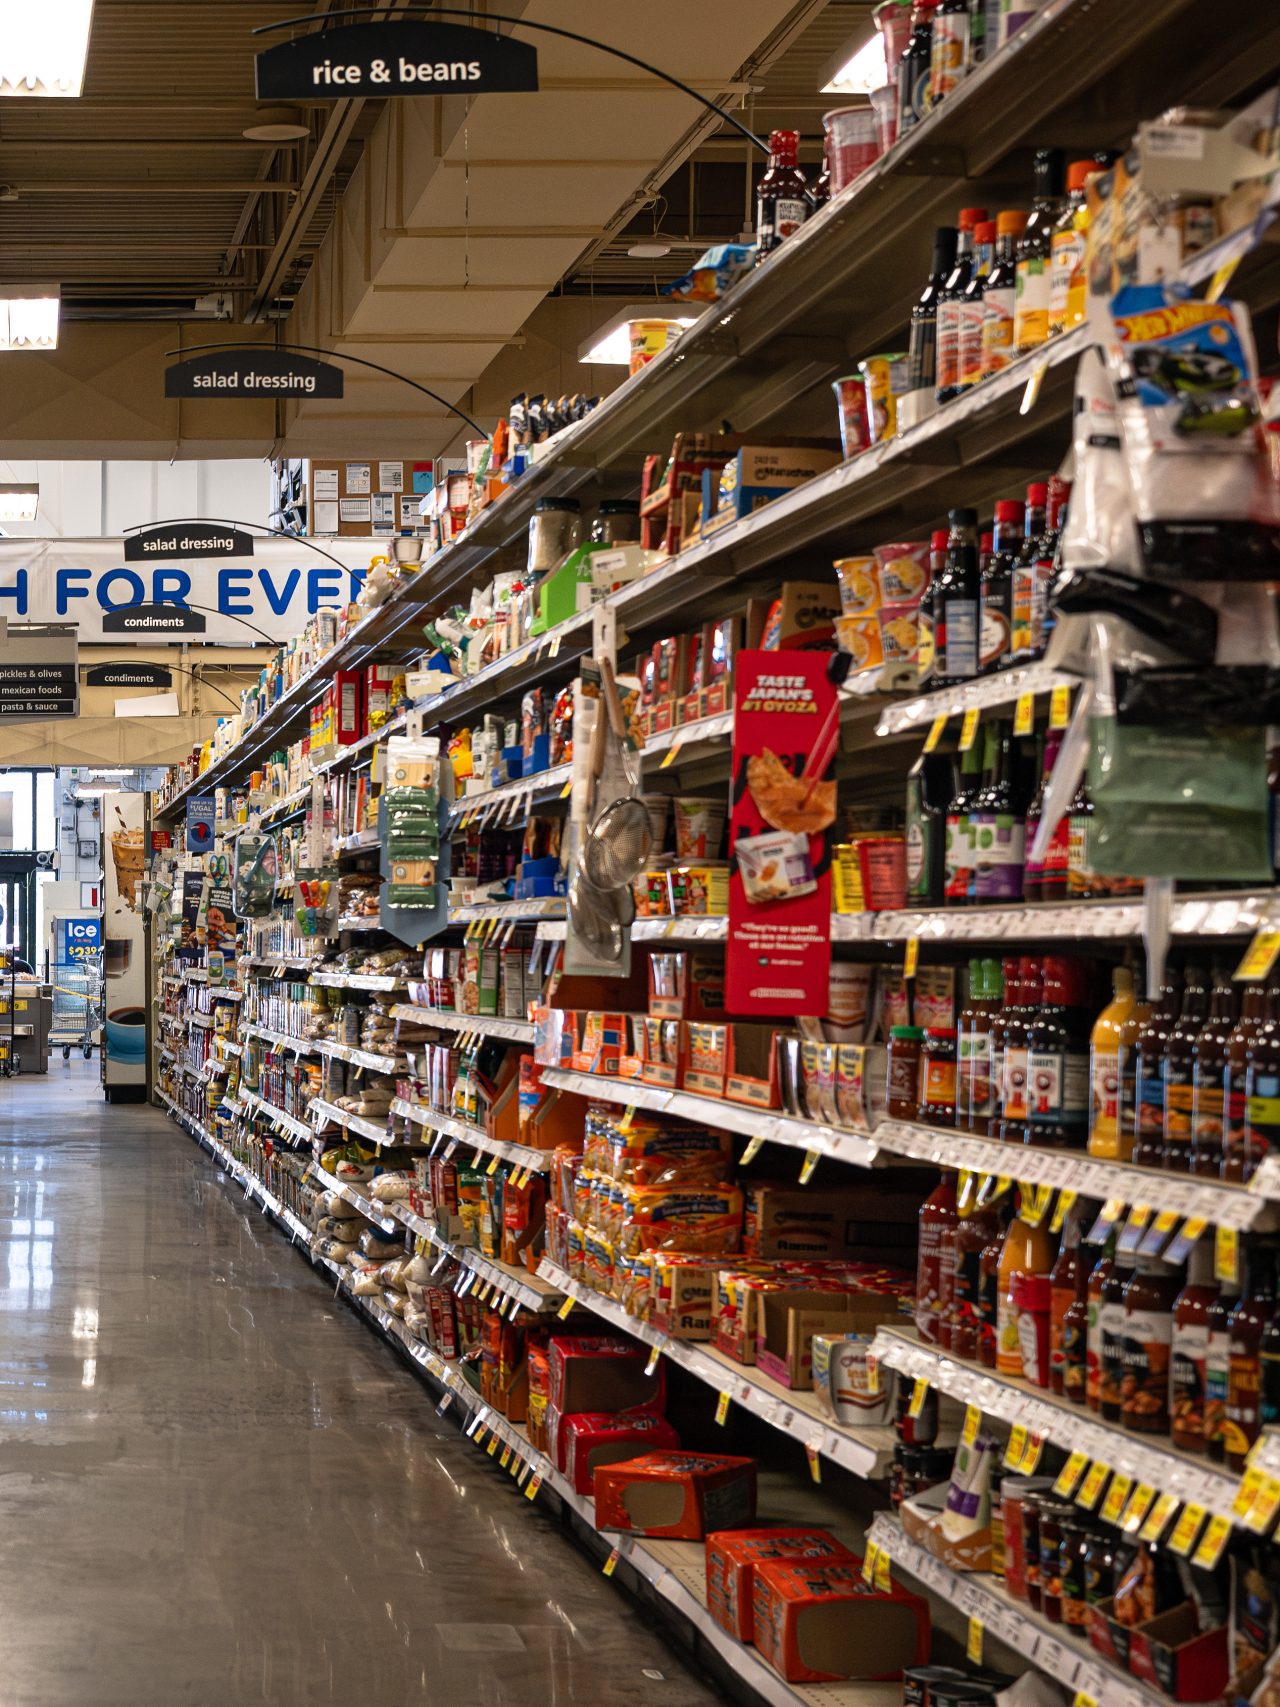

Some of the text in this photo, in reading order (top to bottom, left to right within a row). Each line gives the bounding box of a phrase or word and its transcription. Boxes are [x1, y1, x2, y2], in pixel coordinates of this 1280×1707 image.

[313, 57, 481, 85] rice & beans
[193, 371, 316, 393] salad dressing
[143, 536, 235, 552] salad dressing
[56, 568, 192, 616] FOR
[124, 616, 185, 627] condiments
[0, 669, 62, 681] pickles & olives
[104, 673, 155, 684] condiments
[756, 674, 806, 688] TASTE
[1, 685, 62, 695] mexican foods
[746, 687, 813, 700] JAPAN'S
[1, 702, 58, 713] pasta & sauce
[763, 701, 817, 713] GYOZA
[68, 922, 97, 937] Ice
[777, 1240, 828, 1251] Ramen
